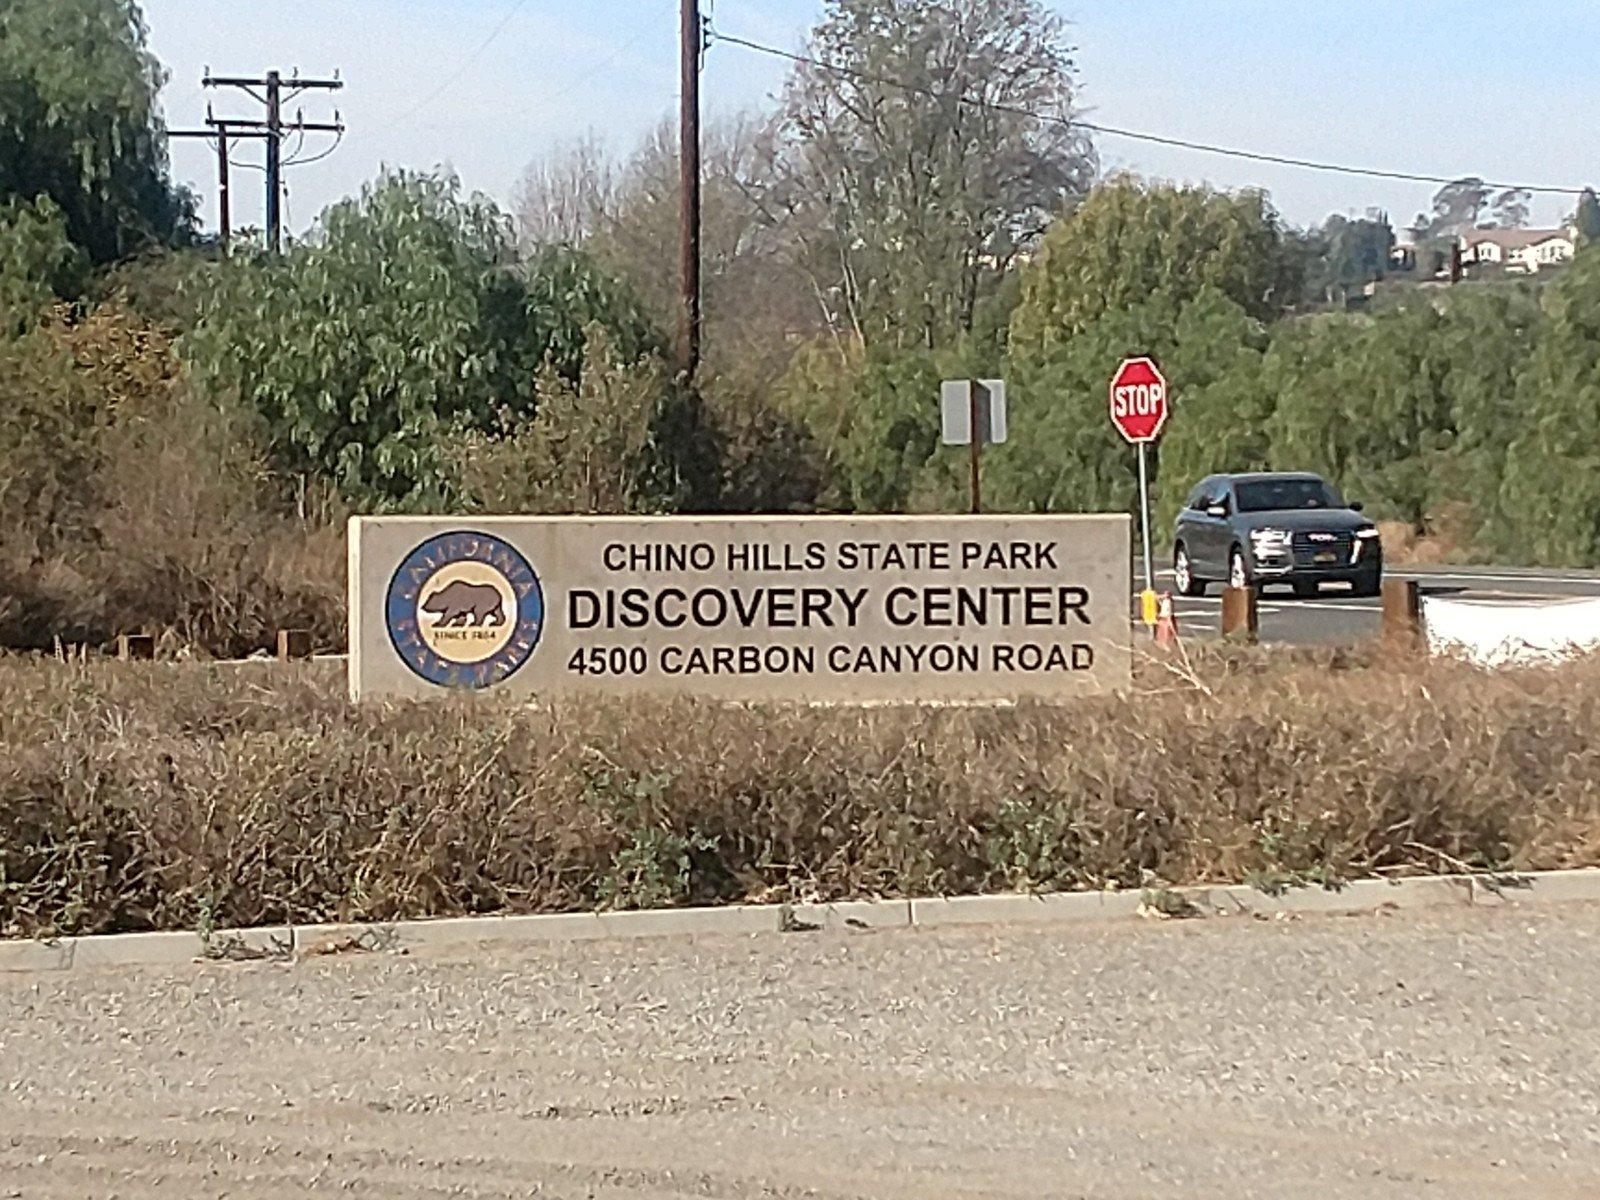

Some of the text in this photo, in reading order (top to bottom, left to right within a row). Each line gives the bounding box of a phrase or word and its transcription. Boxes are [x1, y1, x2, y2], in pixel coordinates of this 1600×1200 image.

[1115, 383, 1162, 417] STOP
[603, 542, 1057, 571] CHINO HILLS STATE PARK
[569, 586, 1090, 628] DISCOVERY CENTER
[568, 646, 646, 675] 4500
[660, 645, 813, 674] CARBON
[828, 644, 978, 672] CANYON
[992, 643, 1093, 671] ROAD
